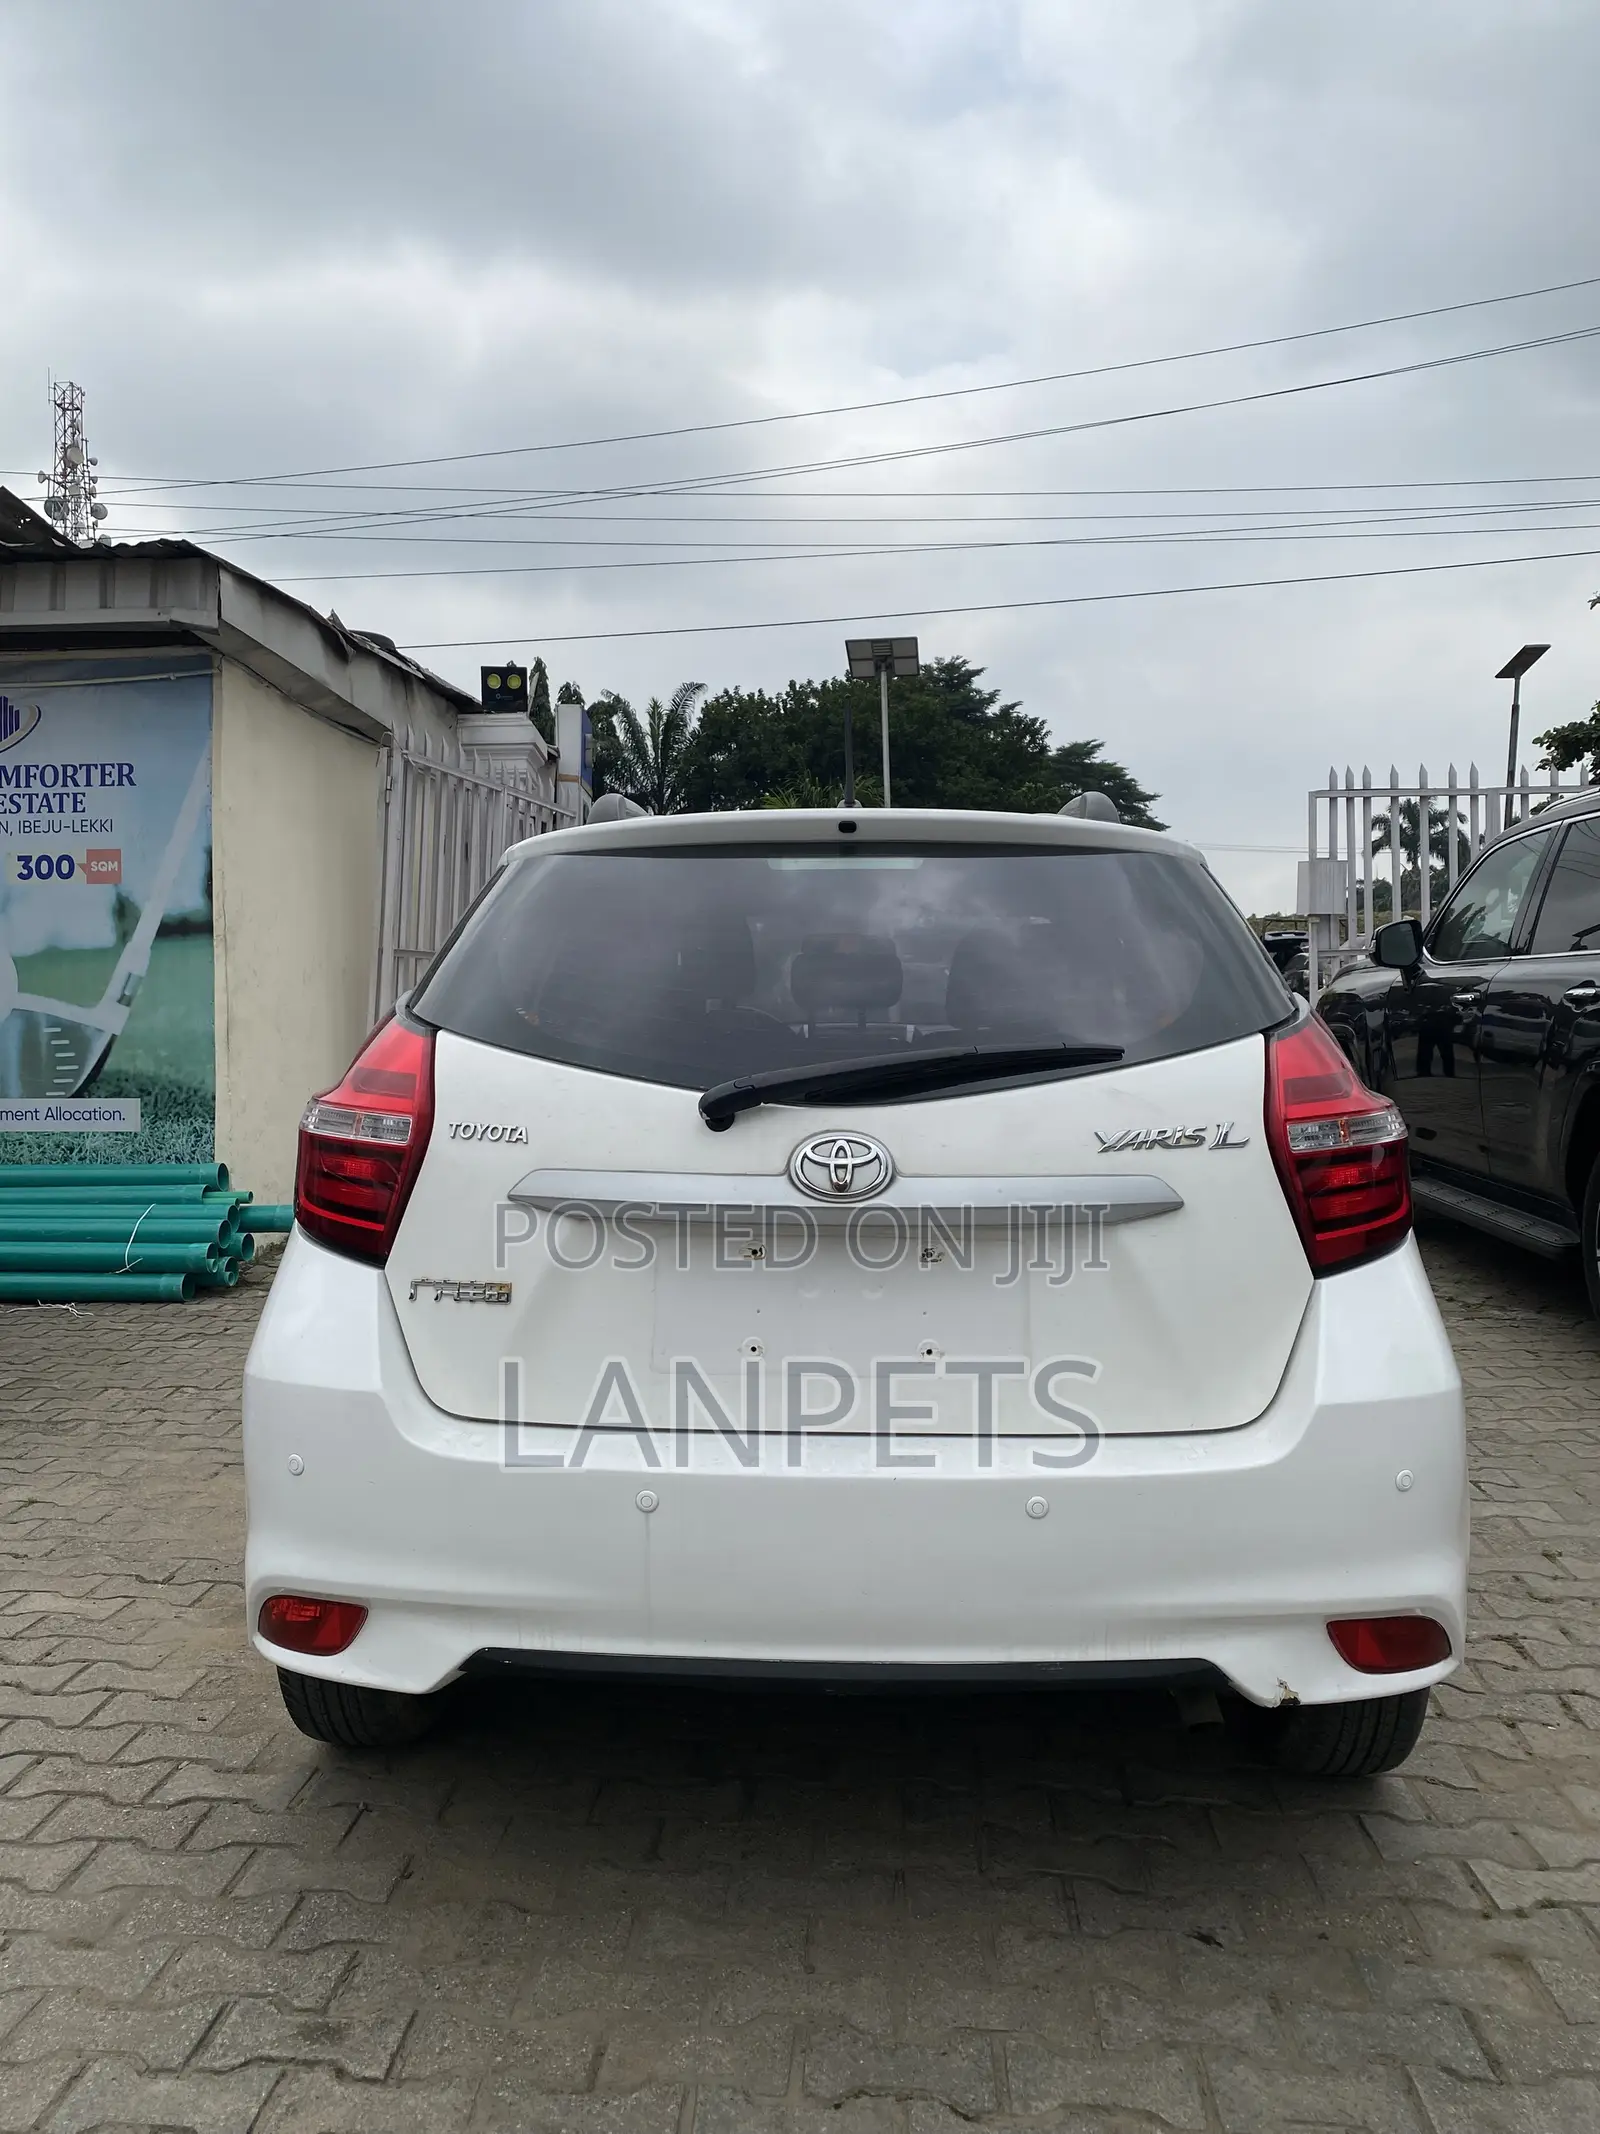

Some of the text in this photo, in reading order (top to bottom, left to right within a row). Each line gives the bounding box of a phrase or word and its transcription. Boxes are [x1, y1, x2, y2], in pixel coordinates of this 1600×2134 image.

[0, 763, 137, 788] MFORTER
[18, 818, 113, 834] IBEJU-LEKKI
[16, 854, 118, 881] 300 SQM
[0, 1106, 126, 1121] ment Allocation.
[449, 1122, 529, 1144] TOYOTA
[1208, 1121, 1250, 1150] L
